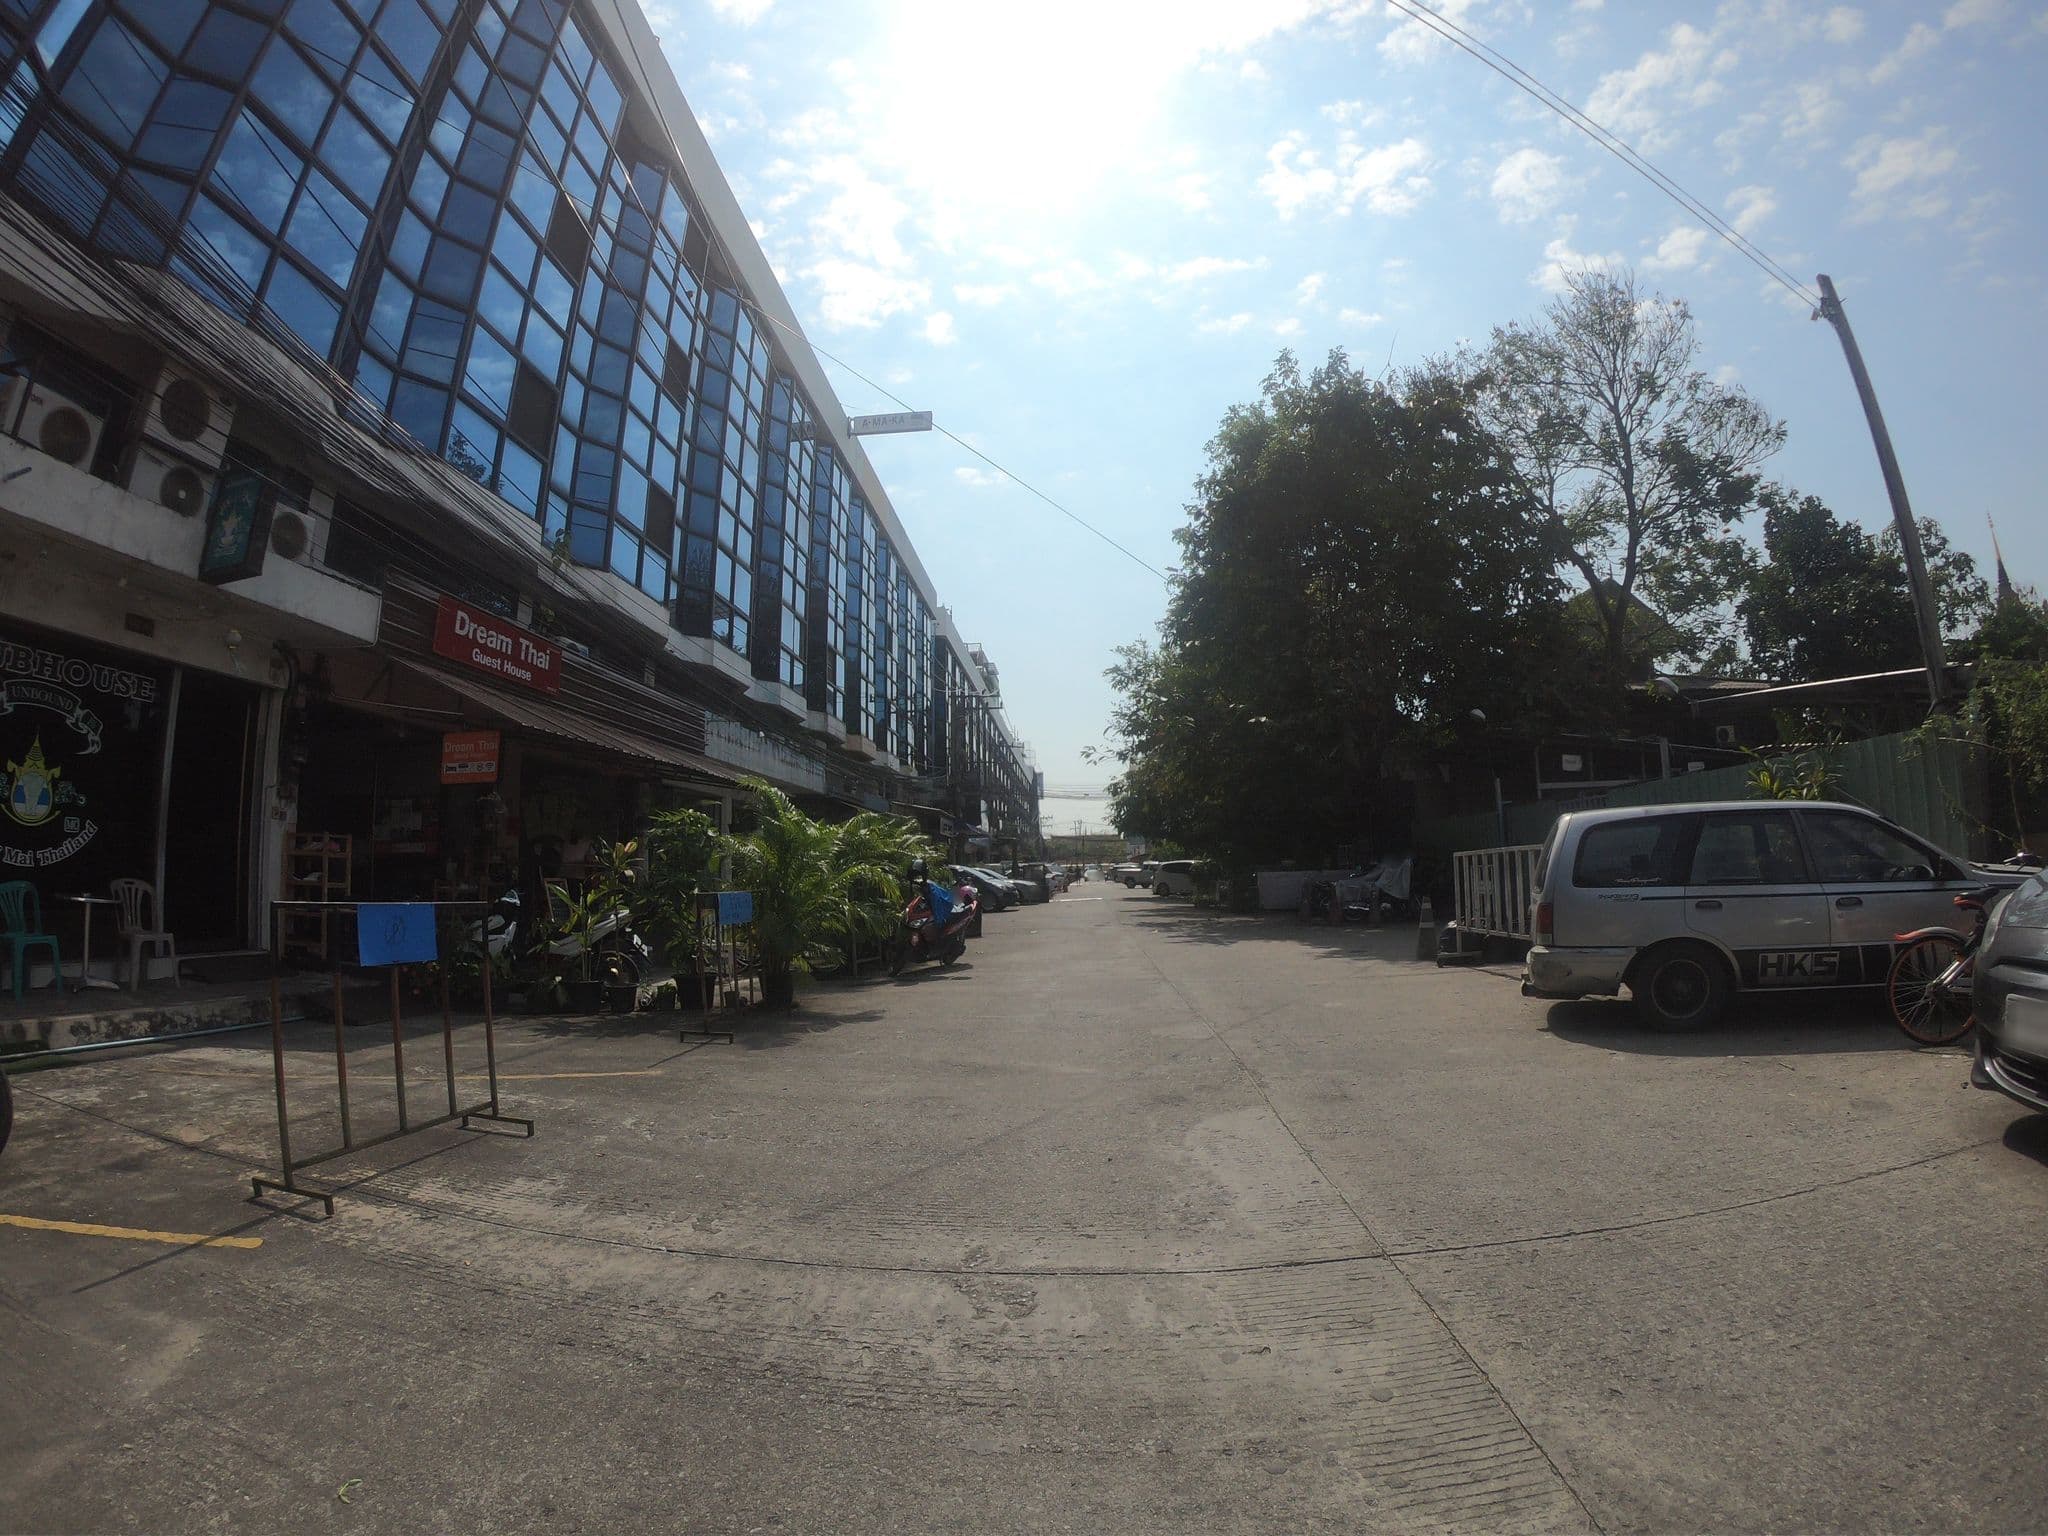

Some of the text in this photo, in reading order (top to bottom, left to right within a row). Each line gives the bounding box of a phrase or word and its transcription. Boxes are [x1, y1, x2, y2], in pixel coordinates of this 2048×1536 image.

[455, 610, 550, 671] Dream Thai
[472, 647, 532, 682] Guest House
[11, 685, 74, 711] UNBOUND
[3, 819, 98, 868] Mai Thailand
[1758, 951, 1840, 981] HKS
